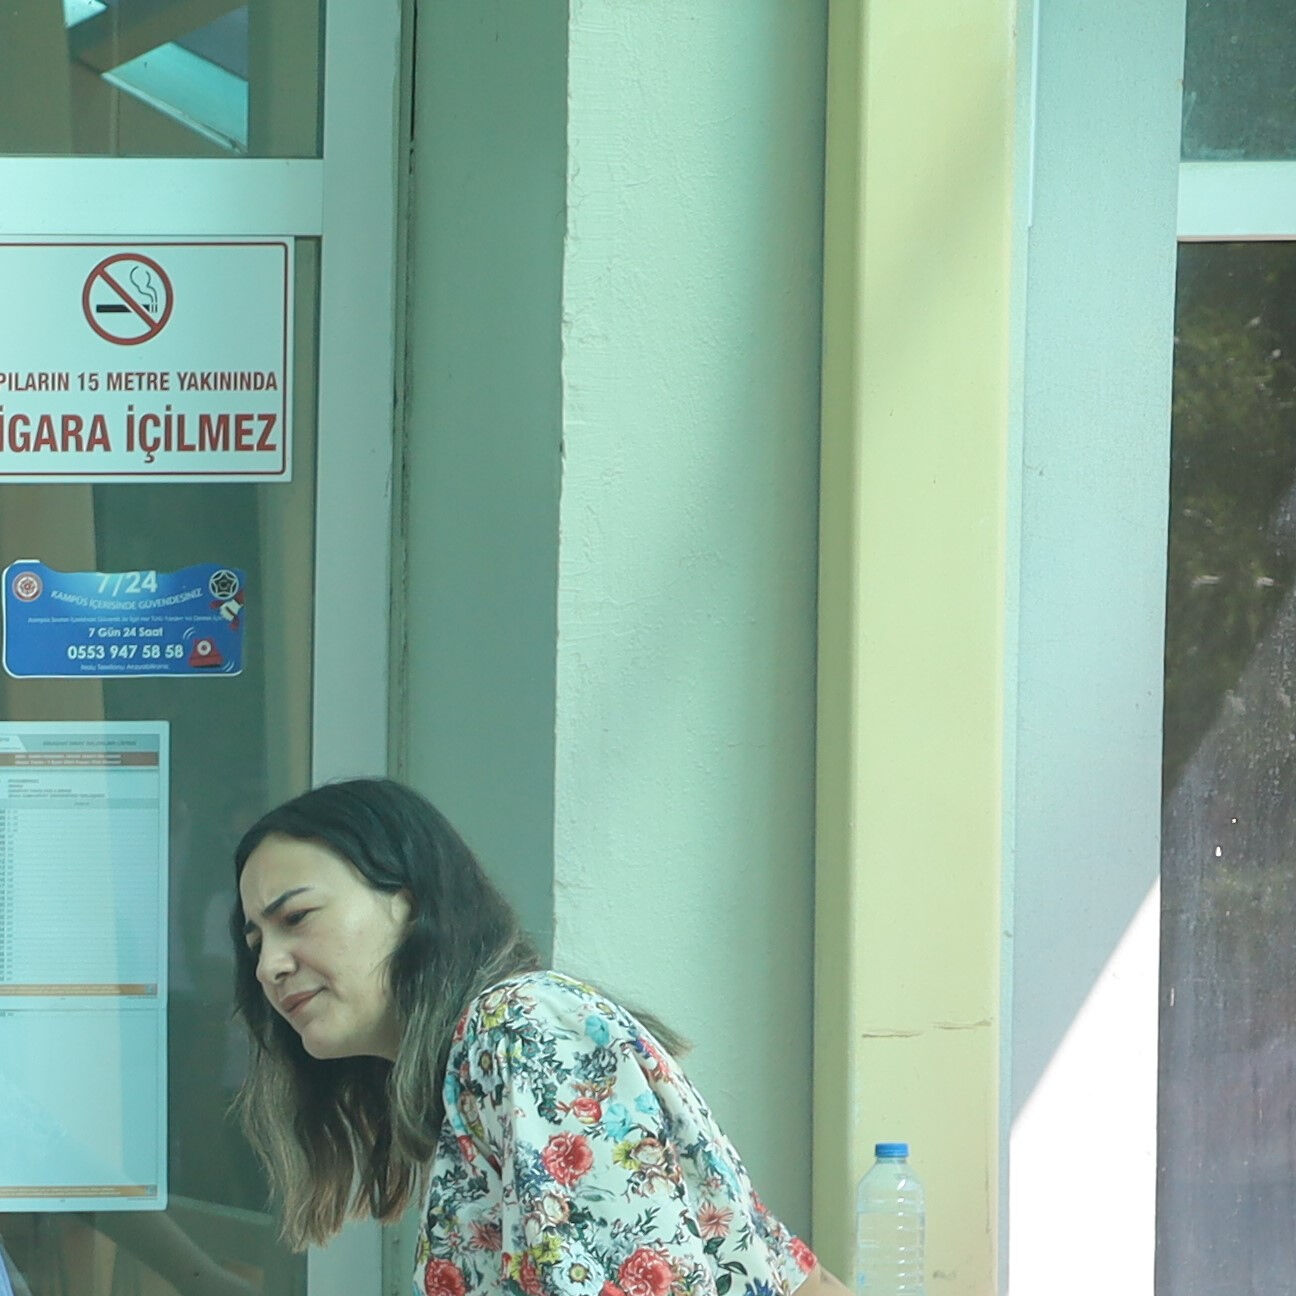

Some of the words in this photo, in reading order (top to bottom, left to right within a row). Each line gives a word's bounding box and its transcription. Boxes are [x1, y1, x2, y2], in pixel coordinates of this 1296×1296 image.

[77, 372, 99, 391] 15
[106, 371, 170, 391] METRE
[177, 371, 278, 391] YAKININDA
[125, 404, 278, 463] İÇİLMEZ
[95, 570, 159, 597] 7/24
[88, 627, 95, 638] 7
[98, 626, 121, 638] Gün
[122, 626, 137, 637] 24
[139, 626, 163, 637] Saat
[67, 645, 105, 660] 0553
[109, 644, 138, 660] 947
[142, 644, 161, 659] 58
[165, 644, 184, 659] 58
